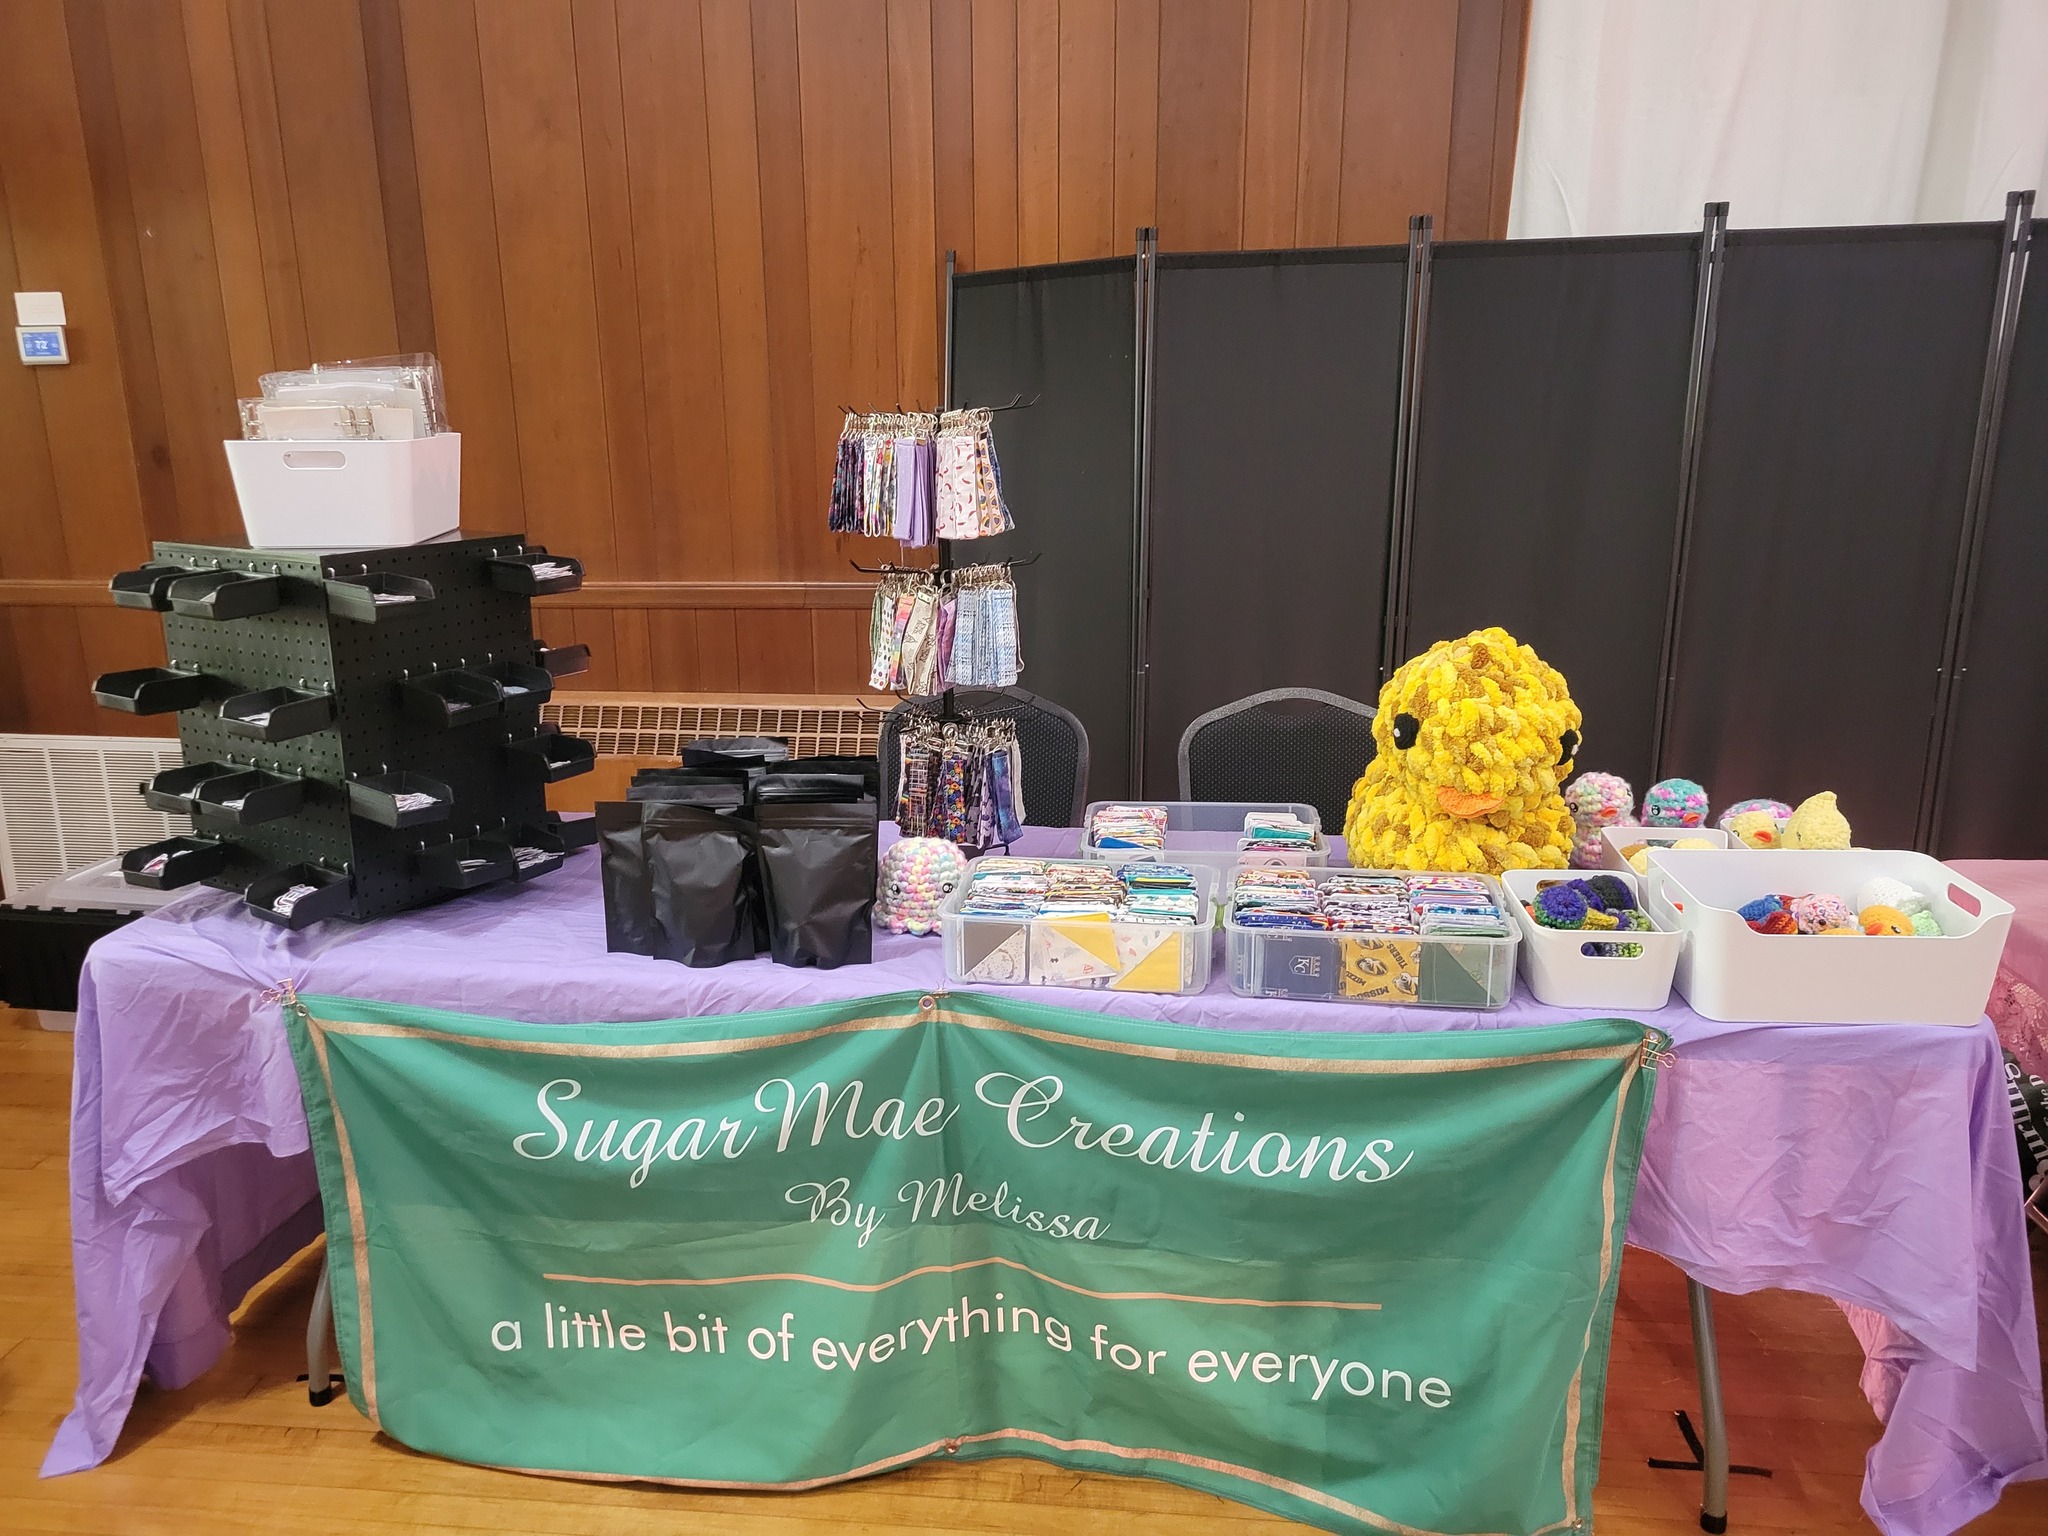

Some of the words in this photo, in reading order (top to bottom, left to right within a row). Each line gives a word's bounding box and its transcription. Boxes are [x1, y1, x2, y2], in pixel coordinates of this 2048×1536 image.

[1386, 942, 1408, 970] TIGERS
[512, 1078, 758, 1189] Sugar
[754, 1077, 960, 1154] Mae
[974, 1071, 1415, 1183] Creations
[784, 1177, 886, 1249] By
[897, 1172, 1111, 1241] Melissa
[490, 1320, 523, 1352] a
[544, 1302, 647, 1350] little
[663, 1310, 729, 1354] bit
[746, 1312, 795, 1362] of
[811, 1292, 1073, 1372] everything
[1089, 1323, 1168, 1375] for
[1187, 1349, 1453, 1409] everyone
